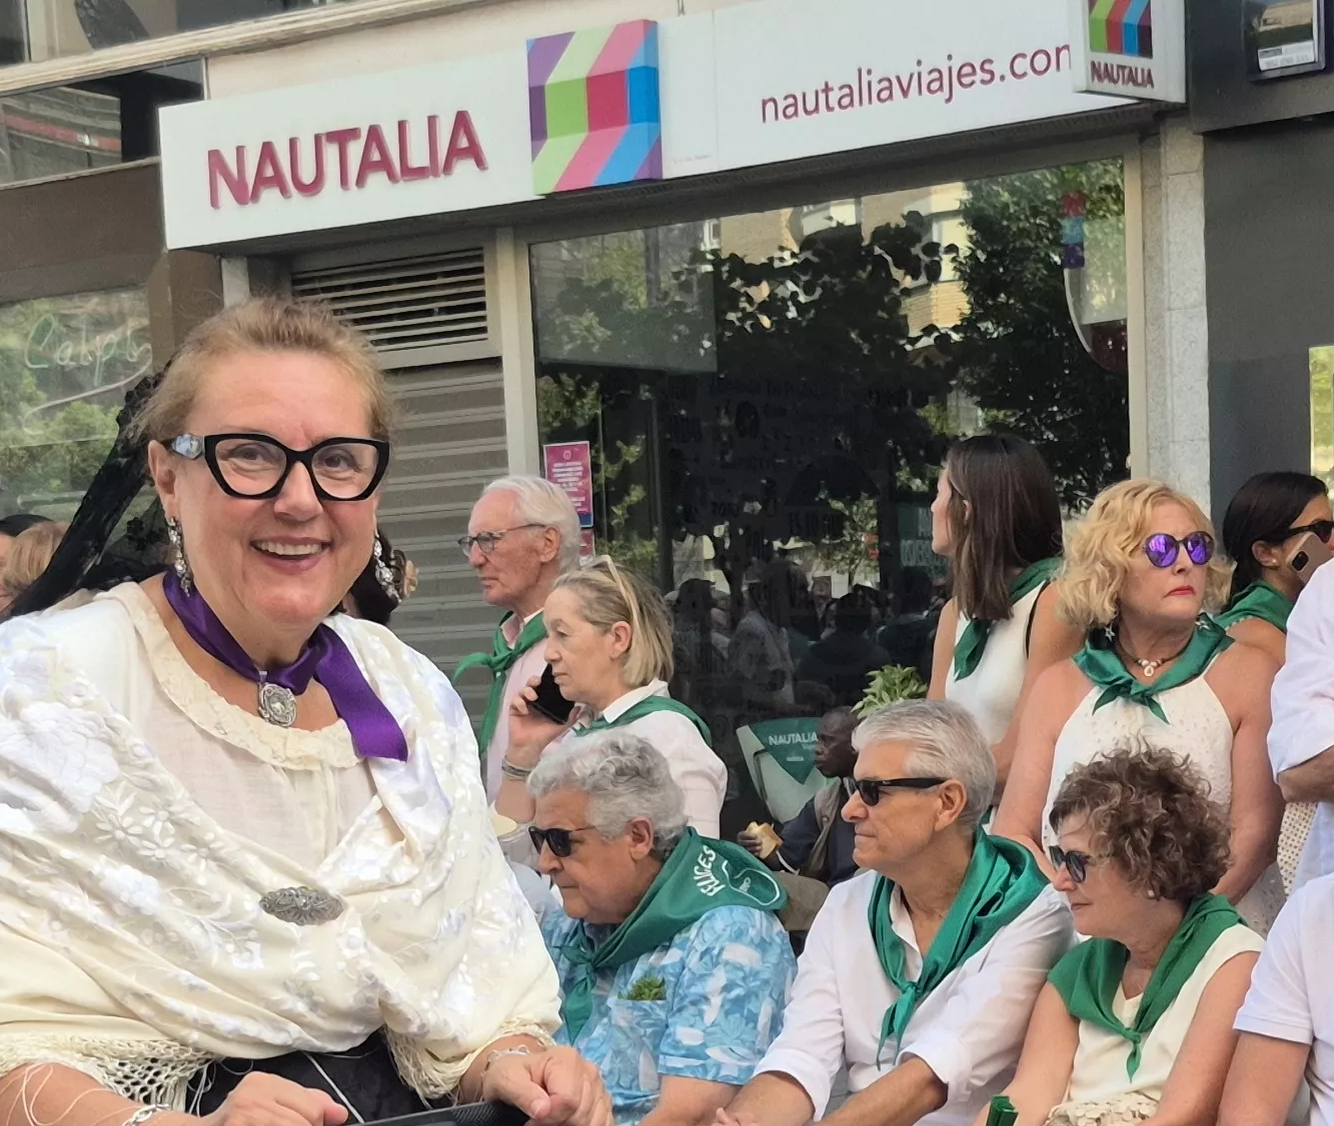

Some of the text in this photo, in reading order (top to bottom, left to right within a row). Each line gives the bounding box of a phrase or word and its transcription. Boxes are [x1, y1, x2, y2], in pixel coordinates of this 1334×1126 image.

[1090, 60, 1155, 88] NAUTALIA
[207, 110, 489, 209] NAUTALIA
[768, 731, 819, 746] NAUTALIA
[693, 844, 726, 897] FELICES
